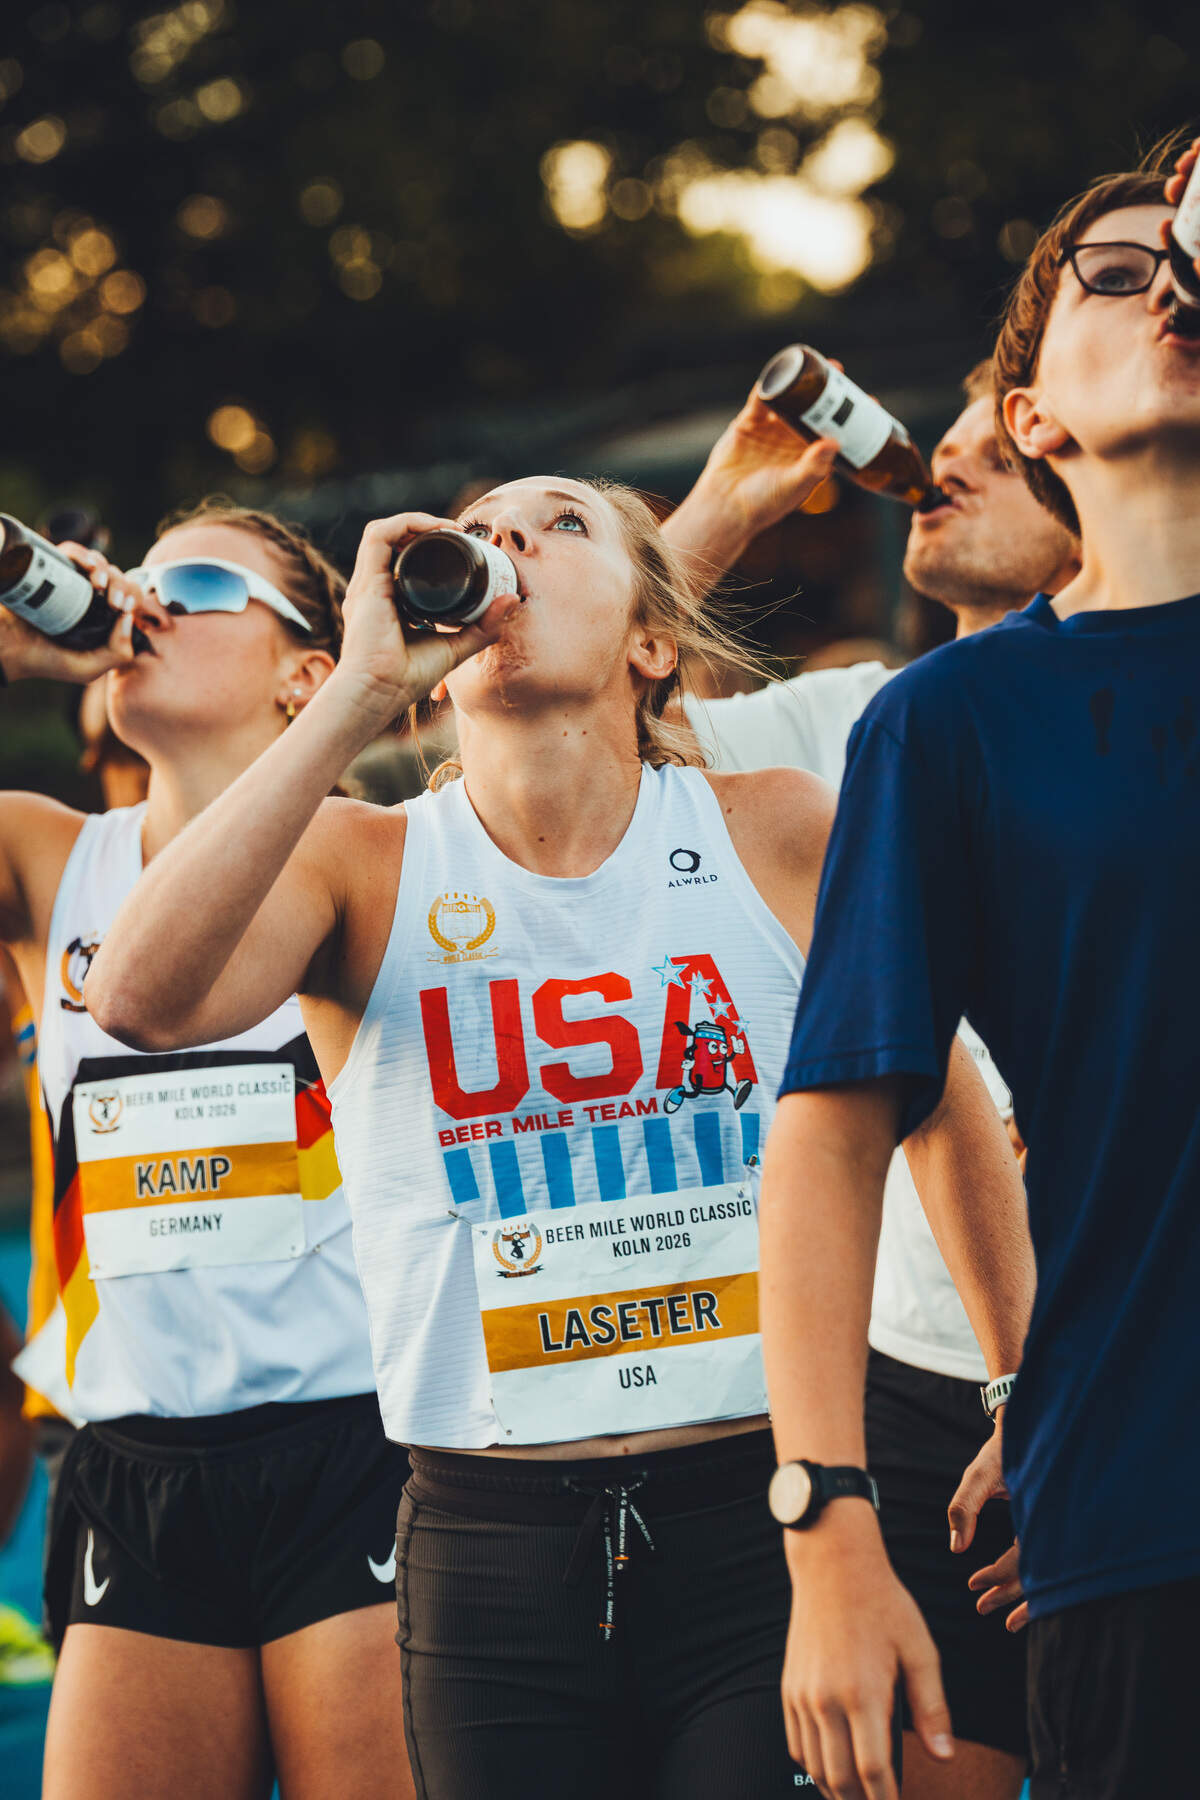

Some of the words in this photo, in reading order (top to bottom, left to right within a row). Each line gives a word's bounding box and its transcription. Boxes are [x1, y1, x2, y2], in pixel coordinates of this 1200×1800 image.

[668, 874, 718, 888] ALWRLD
[419, 953, 759, 1120] USA
[126, 1088, 154, 1106] BEER
[158, 1087, 185, 1103] MILE
[191, 1083, 233, 1099] WORLD
[238, 1080, 292, 1096] CLASSIC
[208, 1104, 237, 1118] 2026
[438, 1121, 503, 1147] BEER
[512, 1109, 575, 1135] MILE
[583, 1097, 659, 1124] TEAM
[136, 1156, 231, 1197] KAMP
[149, 1213, 223, 1237] GERMANY
[545, 1224, 585, 1244] BEER
[589, 1218, 625, 1239] MILE
[630, 1209, 685, 1232] WORLD
[689, 1200, 752, 1224] CLASSIC
[612, 1237, 652, 1258] KOLN
[655, 1232, 692, 1252] 2026
[538, 1291, 722, 1353] LASETER
[618, 1365, 658, 1389] USA
[793, 1773, 815, 1786] BA
